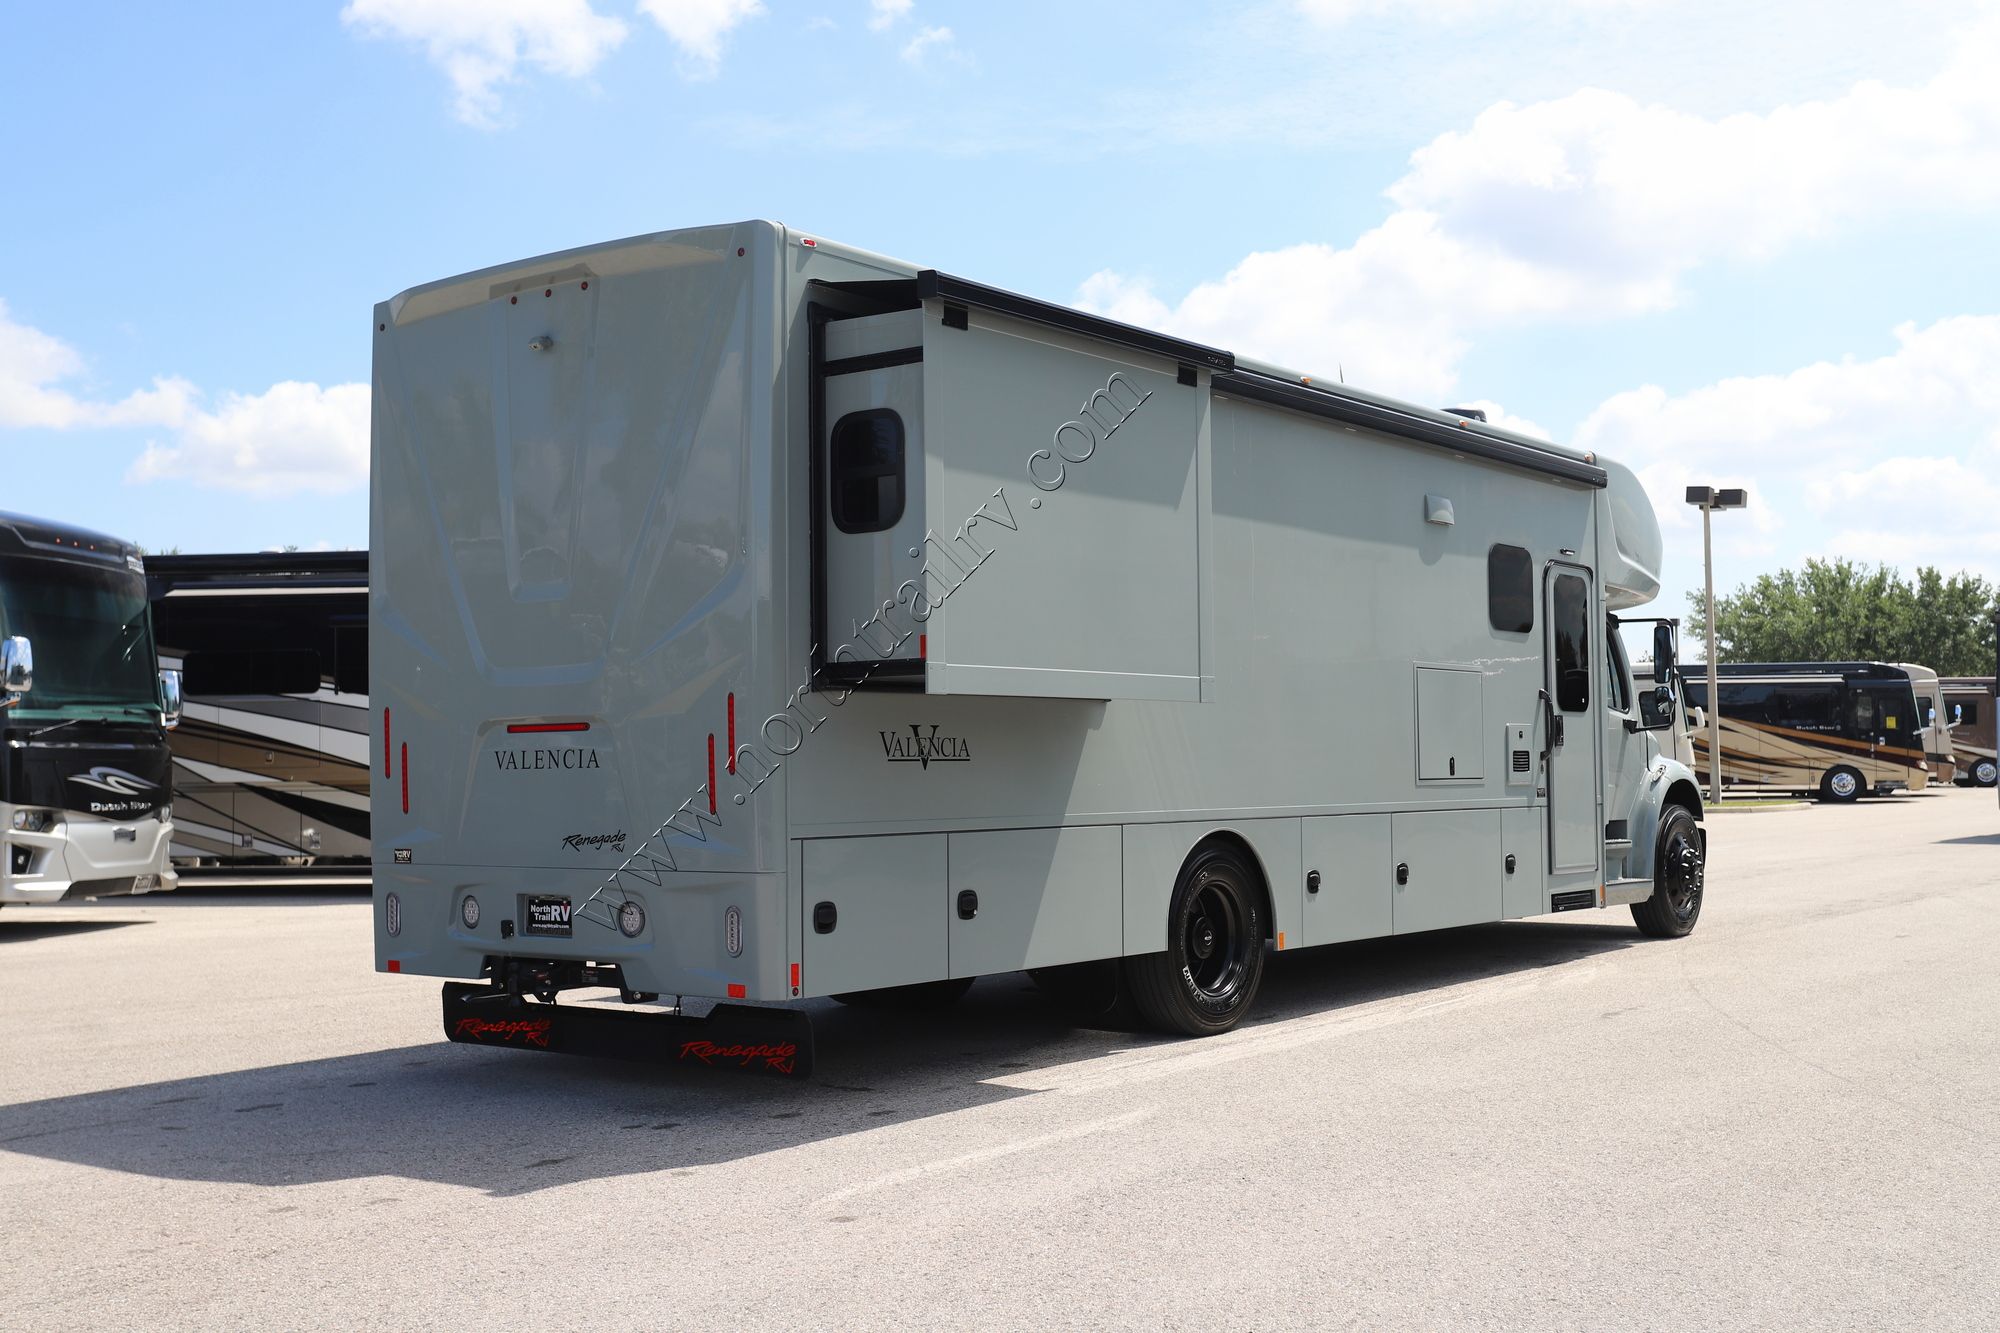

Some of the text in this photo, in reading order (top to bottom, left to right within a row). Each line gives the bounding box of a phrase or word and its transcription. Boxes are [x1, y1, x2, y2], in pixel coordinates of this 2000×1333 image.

[879, 731, 971, 758] VALENCIA
[494, 748, 600, 770] VALENCIA
[562, 829, 627, 852] Renegade
[611, 843, 626, 853] RV
[530, 904, 551, 913] North
[534, 912, 551, 921] Trail
[550, 905, 571, 922] RV
[456, 1018, 552, 1040] Renegade
[524, 1032, 550, 1047] RV
[680, 1040, 797, 1065] Renegade
[766, 1057, 795, 1074] RV
